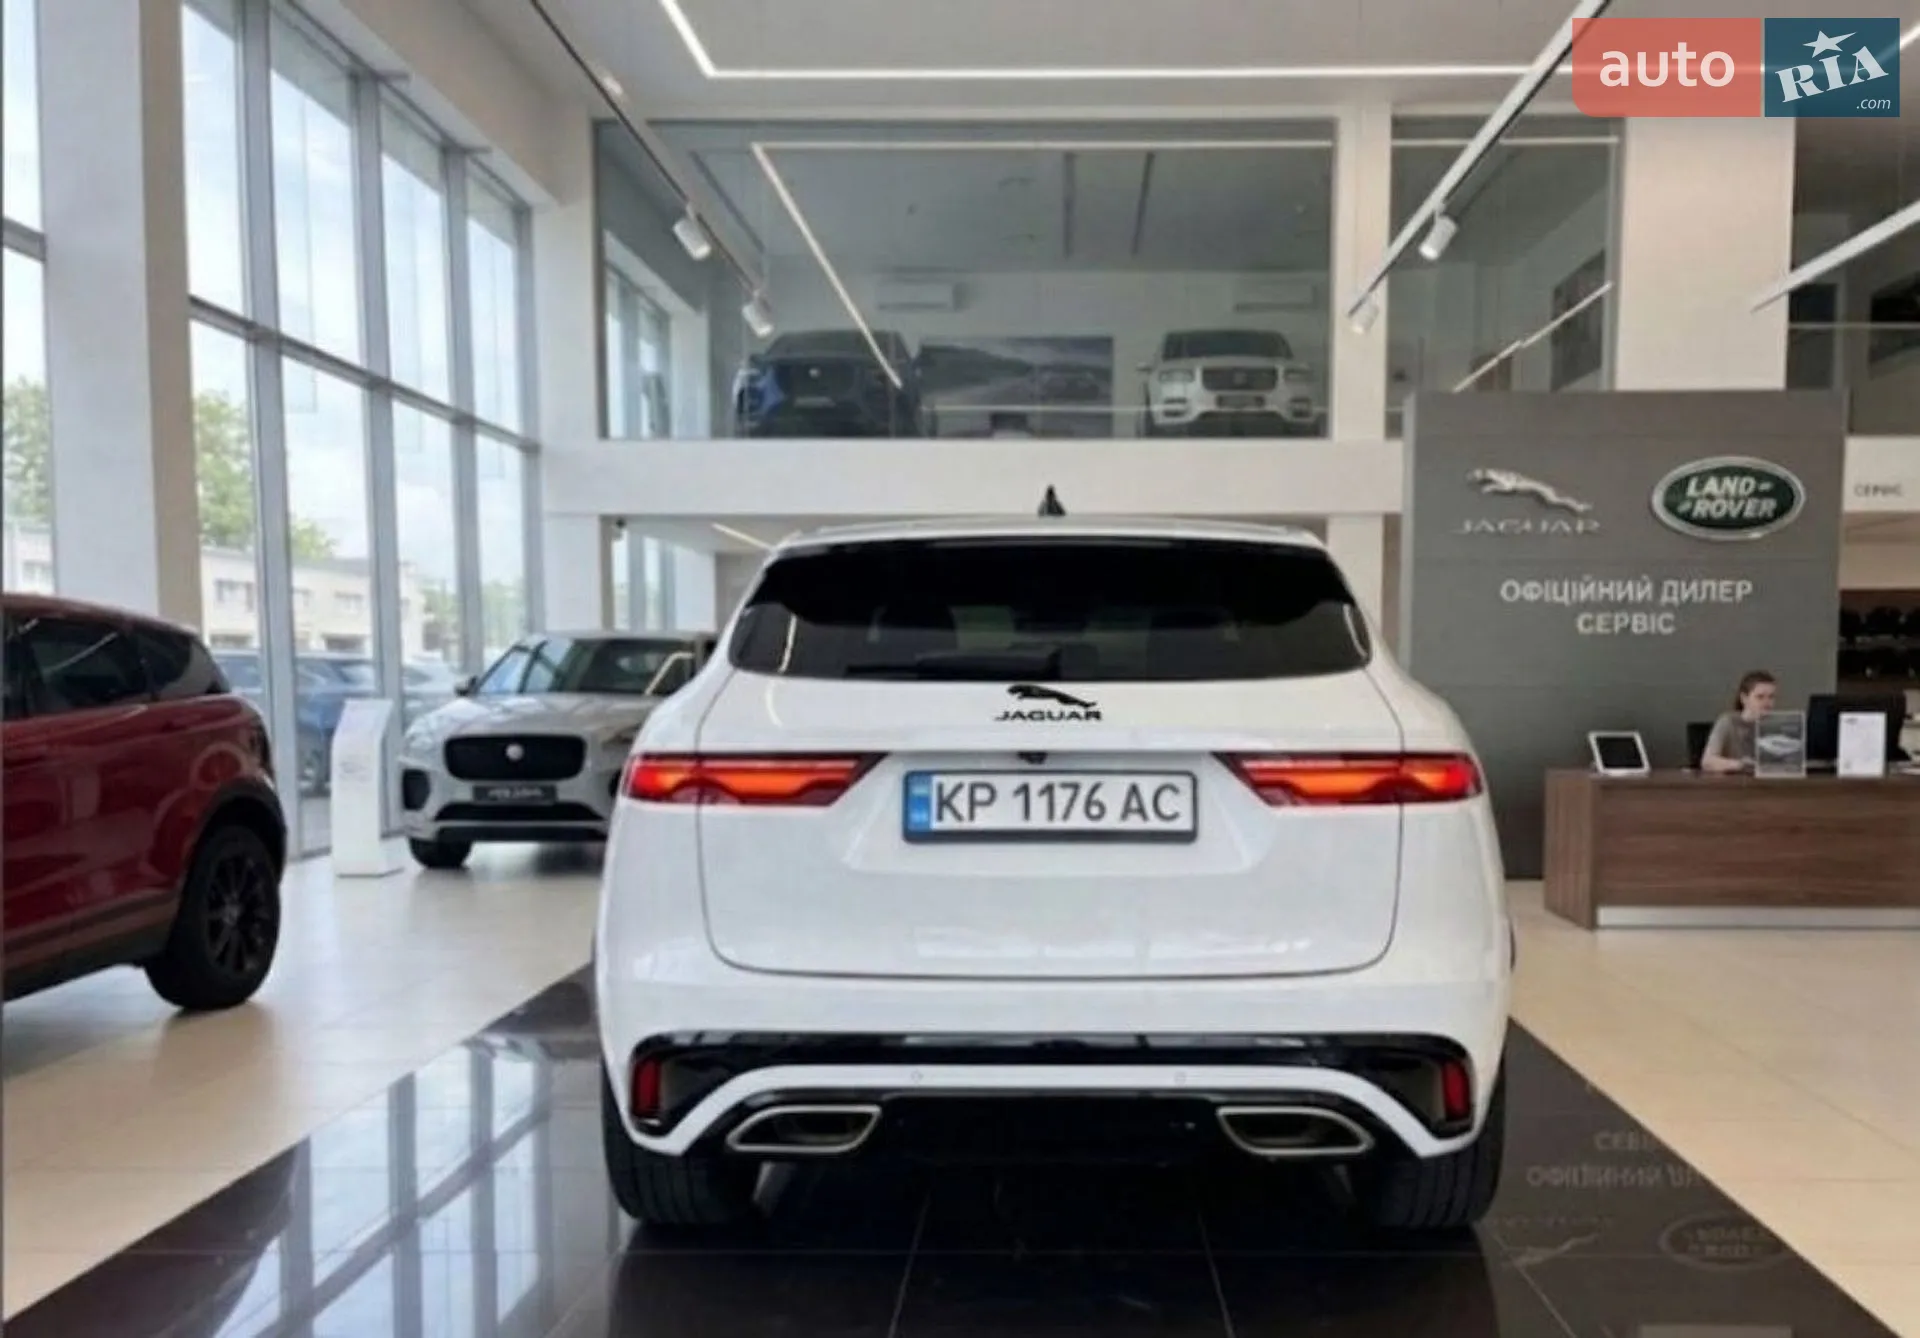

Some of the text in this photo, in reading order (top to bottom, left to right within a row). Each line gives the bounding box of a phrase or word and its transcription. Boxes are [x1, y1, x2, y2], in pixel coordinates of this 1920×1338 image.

[1500, 574, 1753, 606] ОФІЦІЙНИЙ ДИЛЕР
[1576, 611, 1676, 635] СЕРВІС
[994, 709, 1102, 721] JAGUAR
[936, 782, 1181, 822] KP 1176 AC
